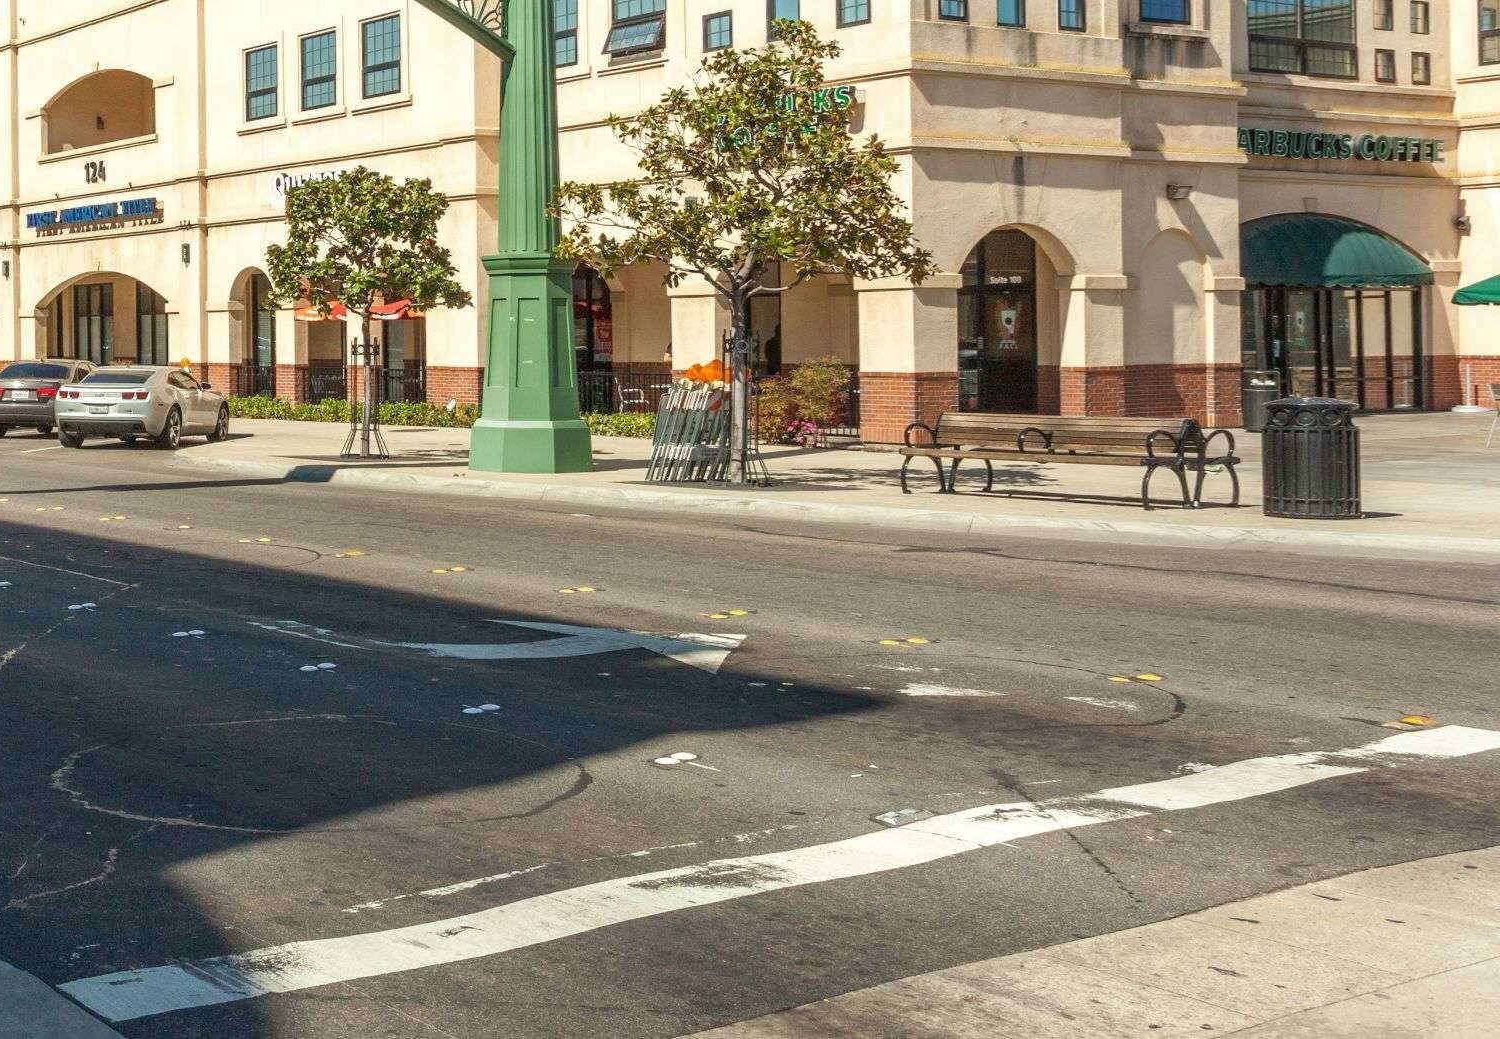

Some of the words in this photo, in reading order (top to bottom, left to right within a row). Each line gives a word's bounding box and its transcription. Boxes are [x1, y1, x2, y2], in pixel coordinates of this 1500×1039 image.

[1360, 132, 1445, 163] COFFEE
[84, 160, 106, 184] 124
[60, 202, 118, 224] AMERICAN
